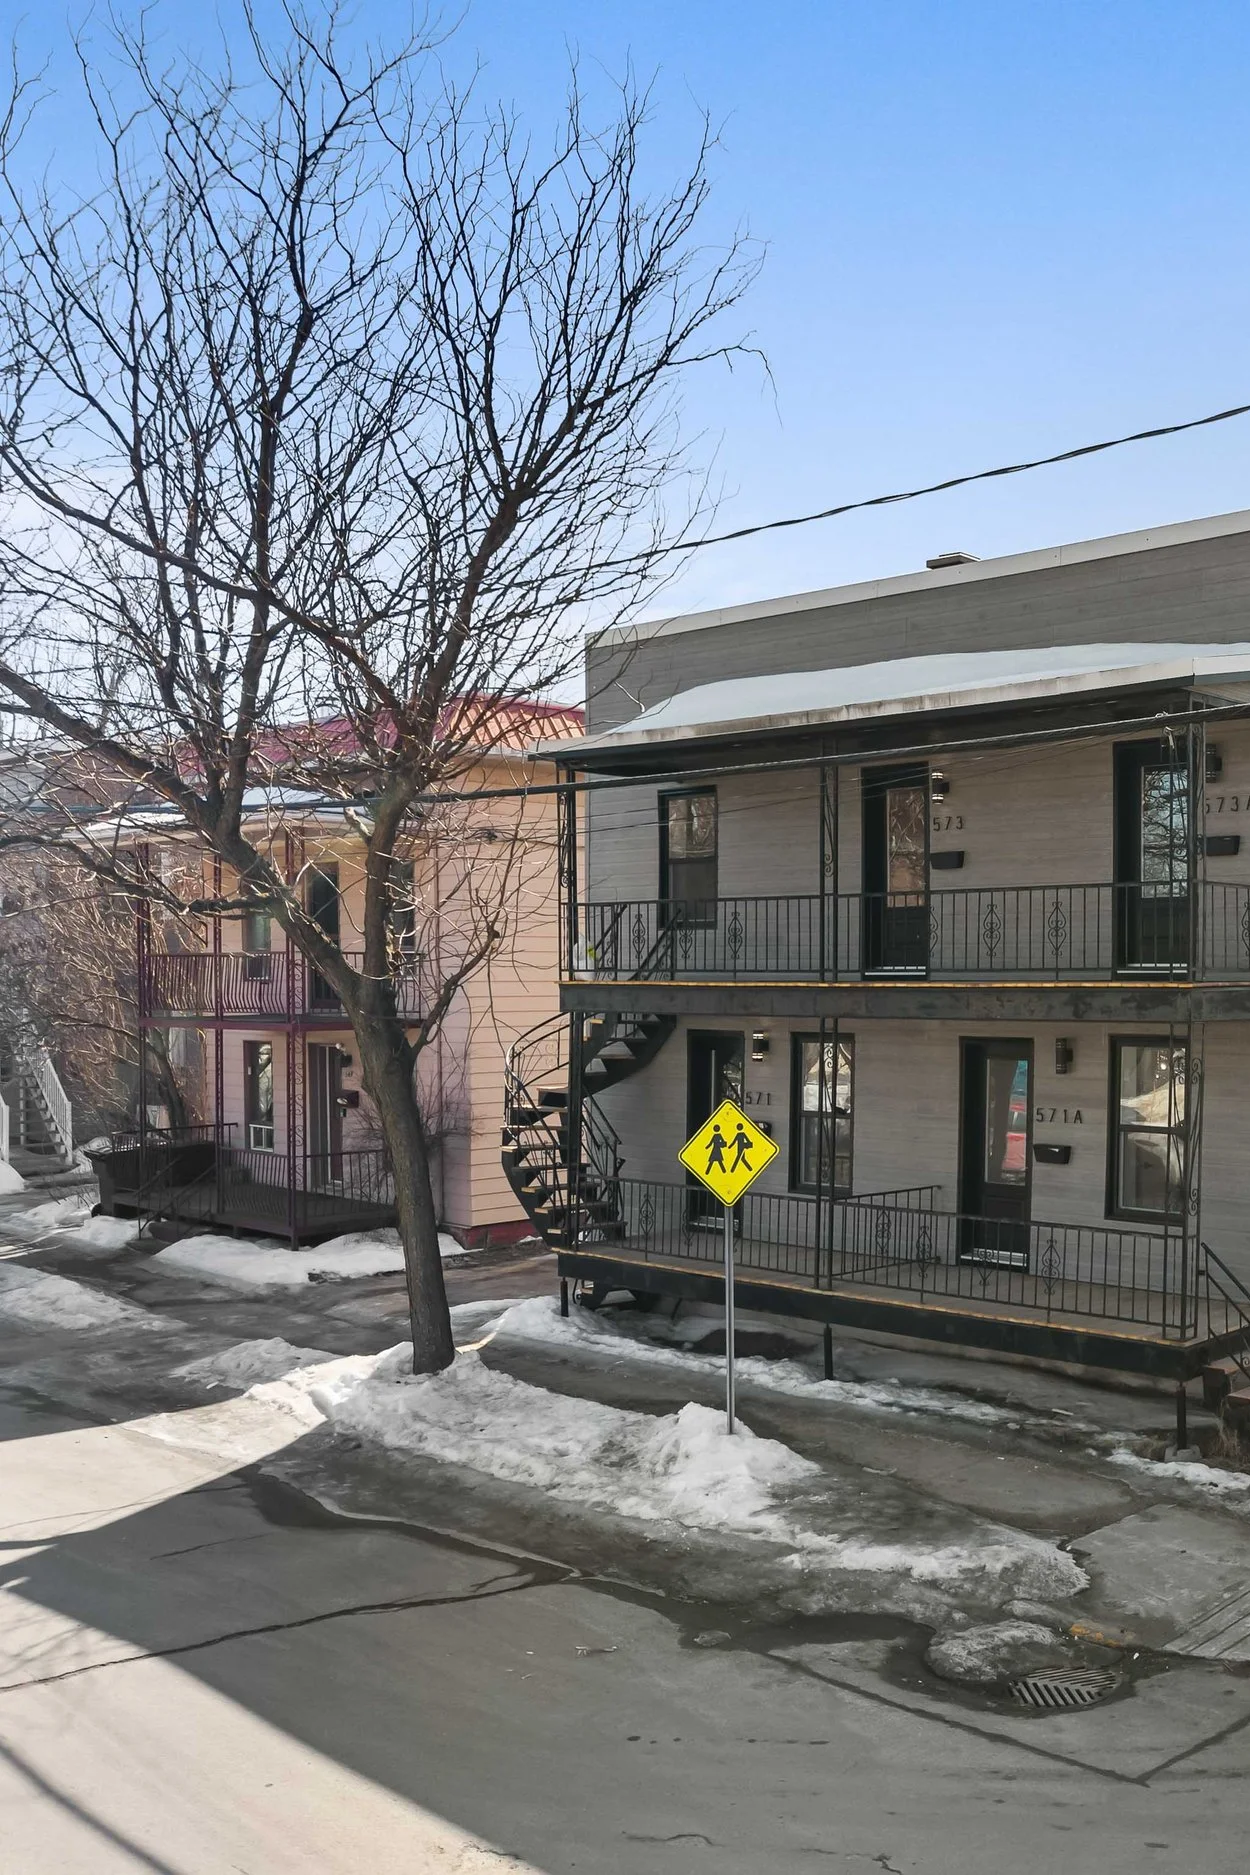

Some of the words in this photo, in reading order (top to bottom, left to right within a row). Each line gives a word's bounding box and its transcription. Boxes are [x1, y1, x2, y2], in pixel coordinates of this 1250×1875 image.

[933, 816, 963, 831] 573
[745, 1091, 771, 1106] 571
[1036, 1107, 1083, 1124] 571A
